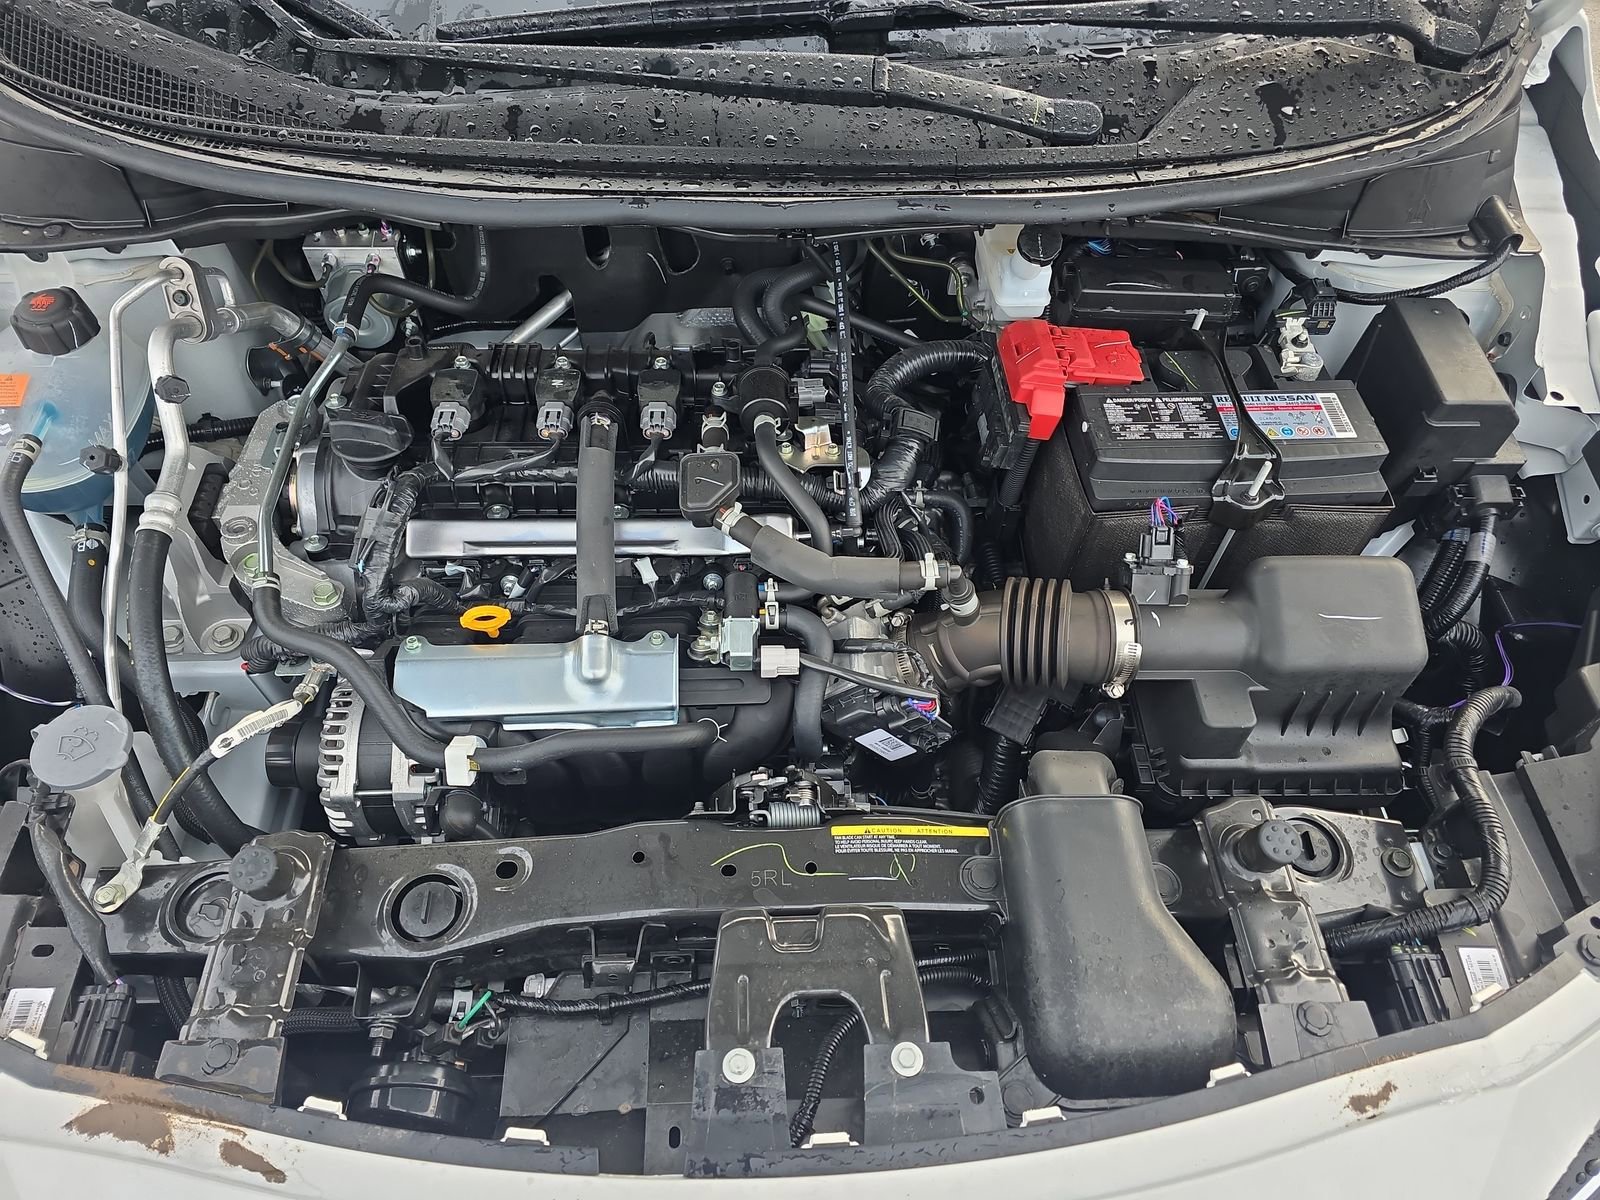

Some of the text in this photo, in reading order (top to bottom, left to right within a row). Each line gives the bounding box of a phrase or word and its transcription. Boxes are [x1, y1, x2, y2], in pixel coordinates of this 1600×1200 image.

[1216, 394, 1315, 403] REULT NISSAN
[750, 869, 792, 887] 5RL
